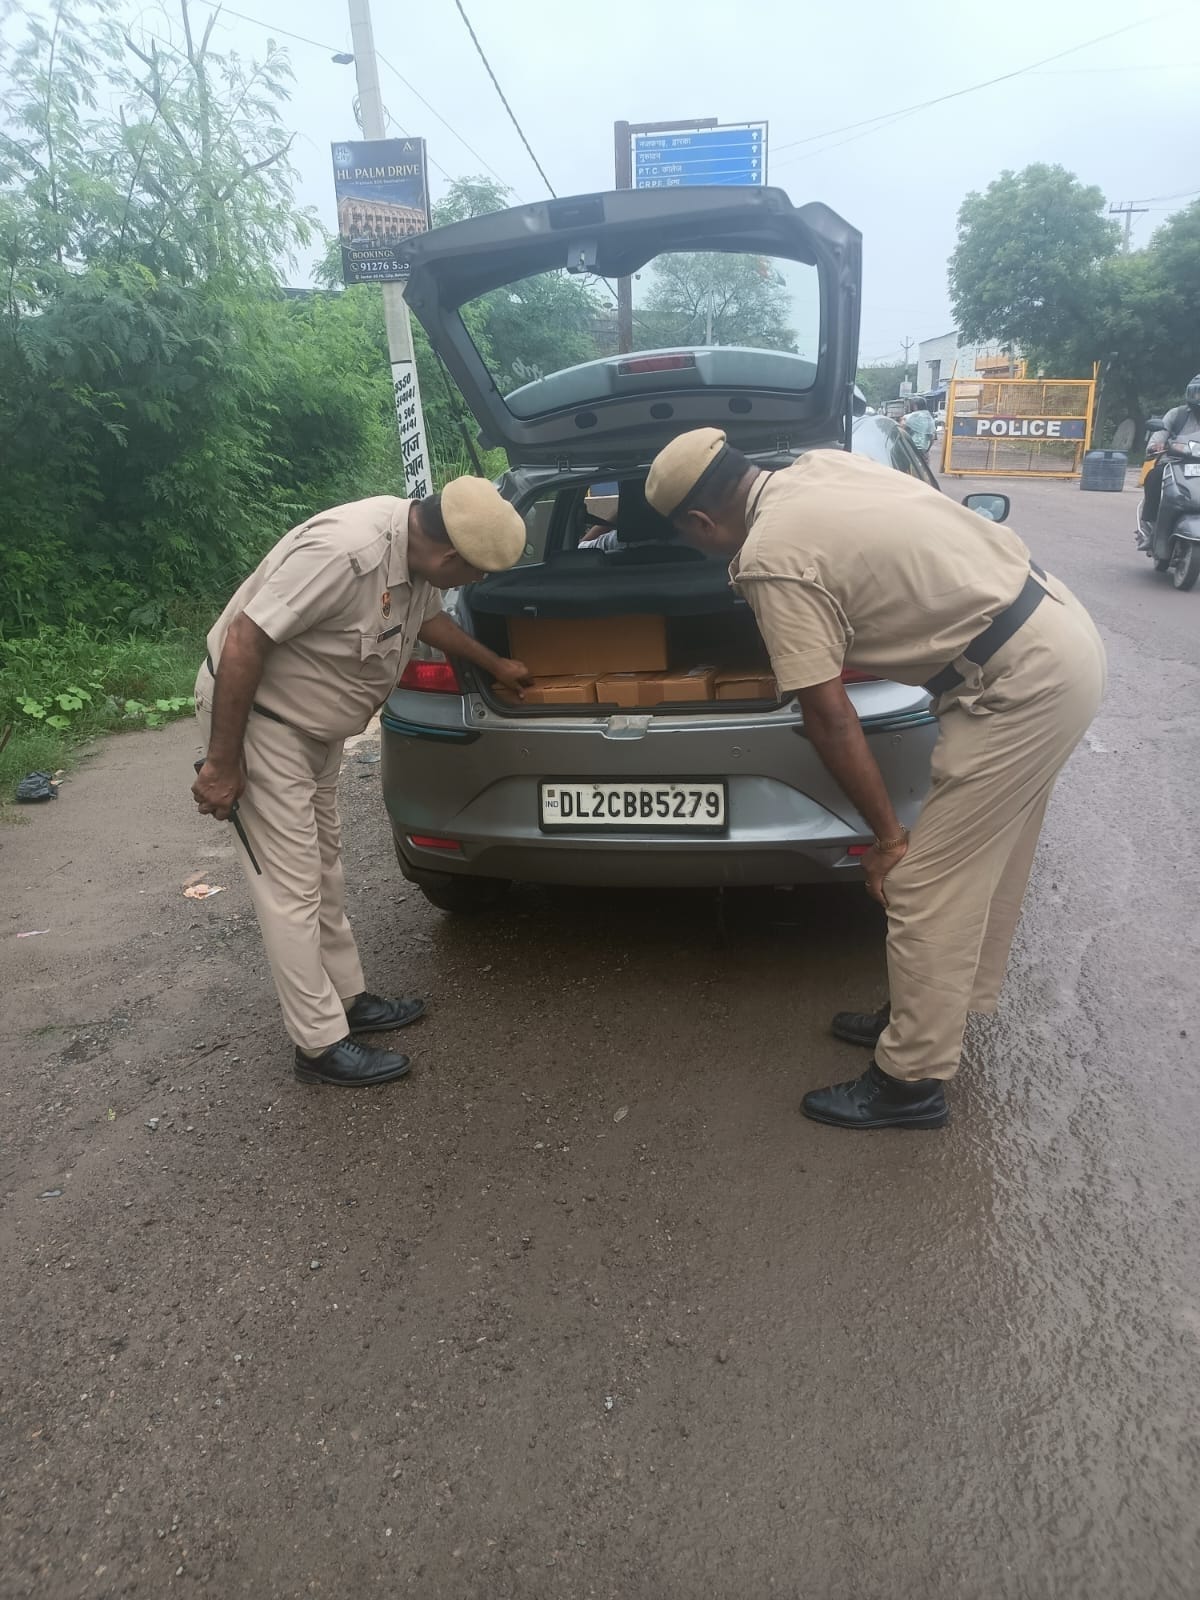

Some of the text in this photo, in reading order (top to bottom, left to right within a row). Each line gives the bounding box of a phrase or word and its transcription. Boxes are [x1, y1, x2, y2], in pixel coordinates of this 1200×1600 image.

[337, 164, 420, 180] HL PALM DRIVE
[352, 250, 395, 259] BOOKINGS
[360, 262, 389, 271] 91276
[976, 419, 1062, 437] POLICE
[401, 431, 421, 463] राज
[404, 453, 424, 483] स्थान
[560, 791, 720, 818] DL2CBB5279
